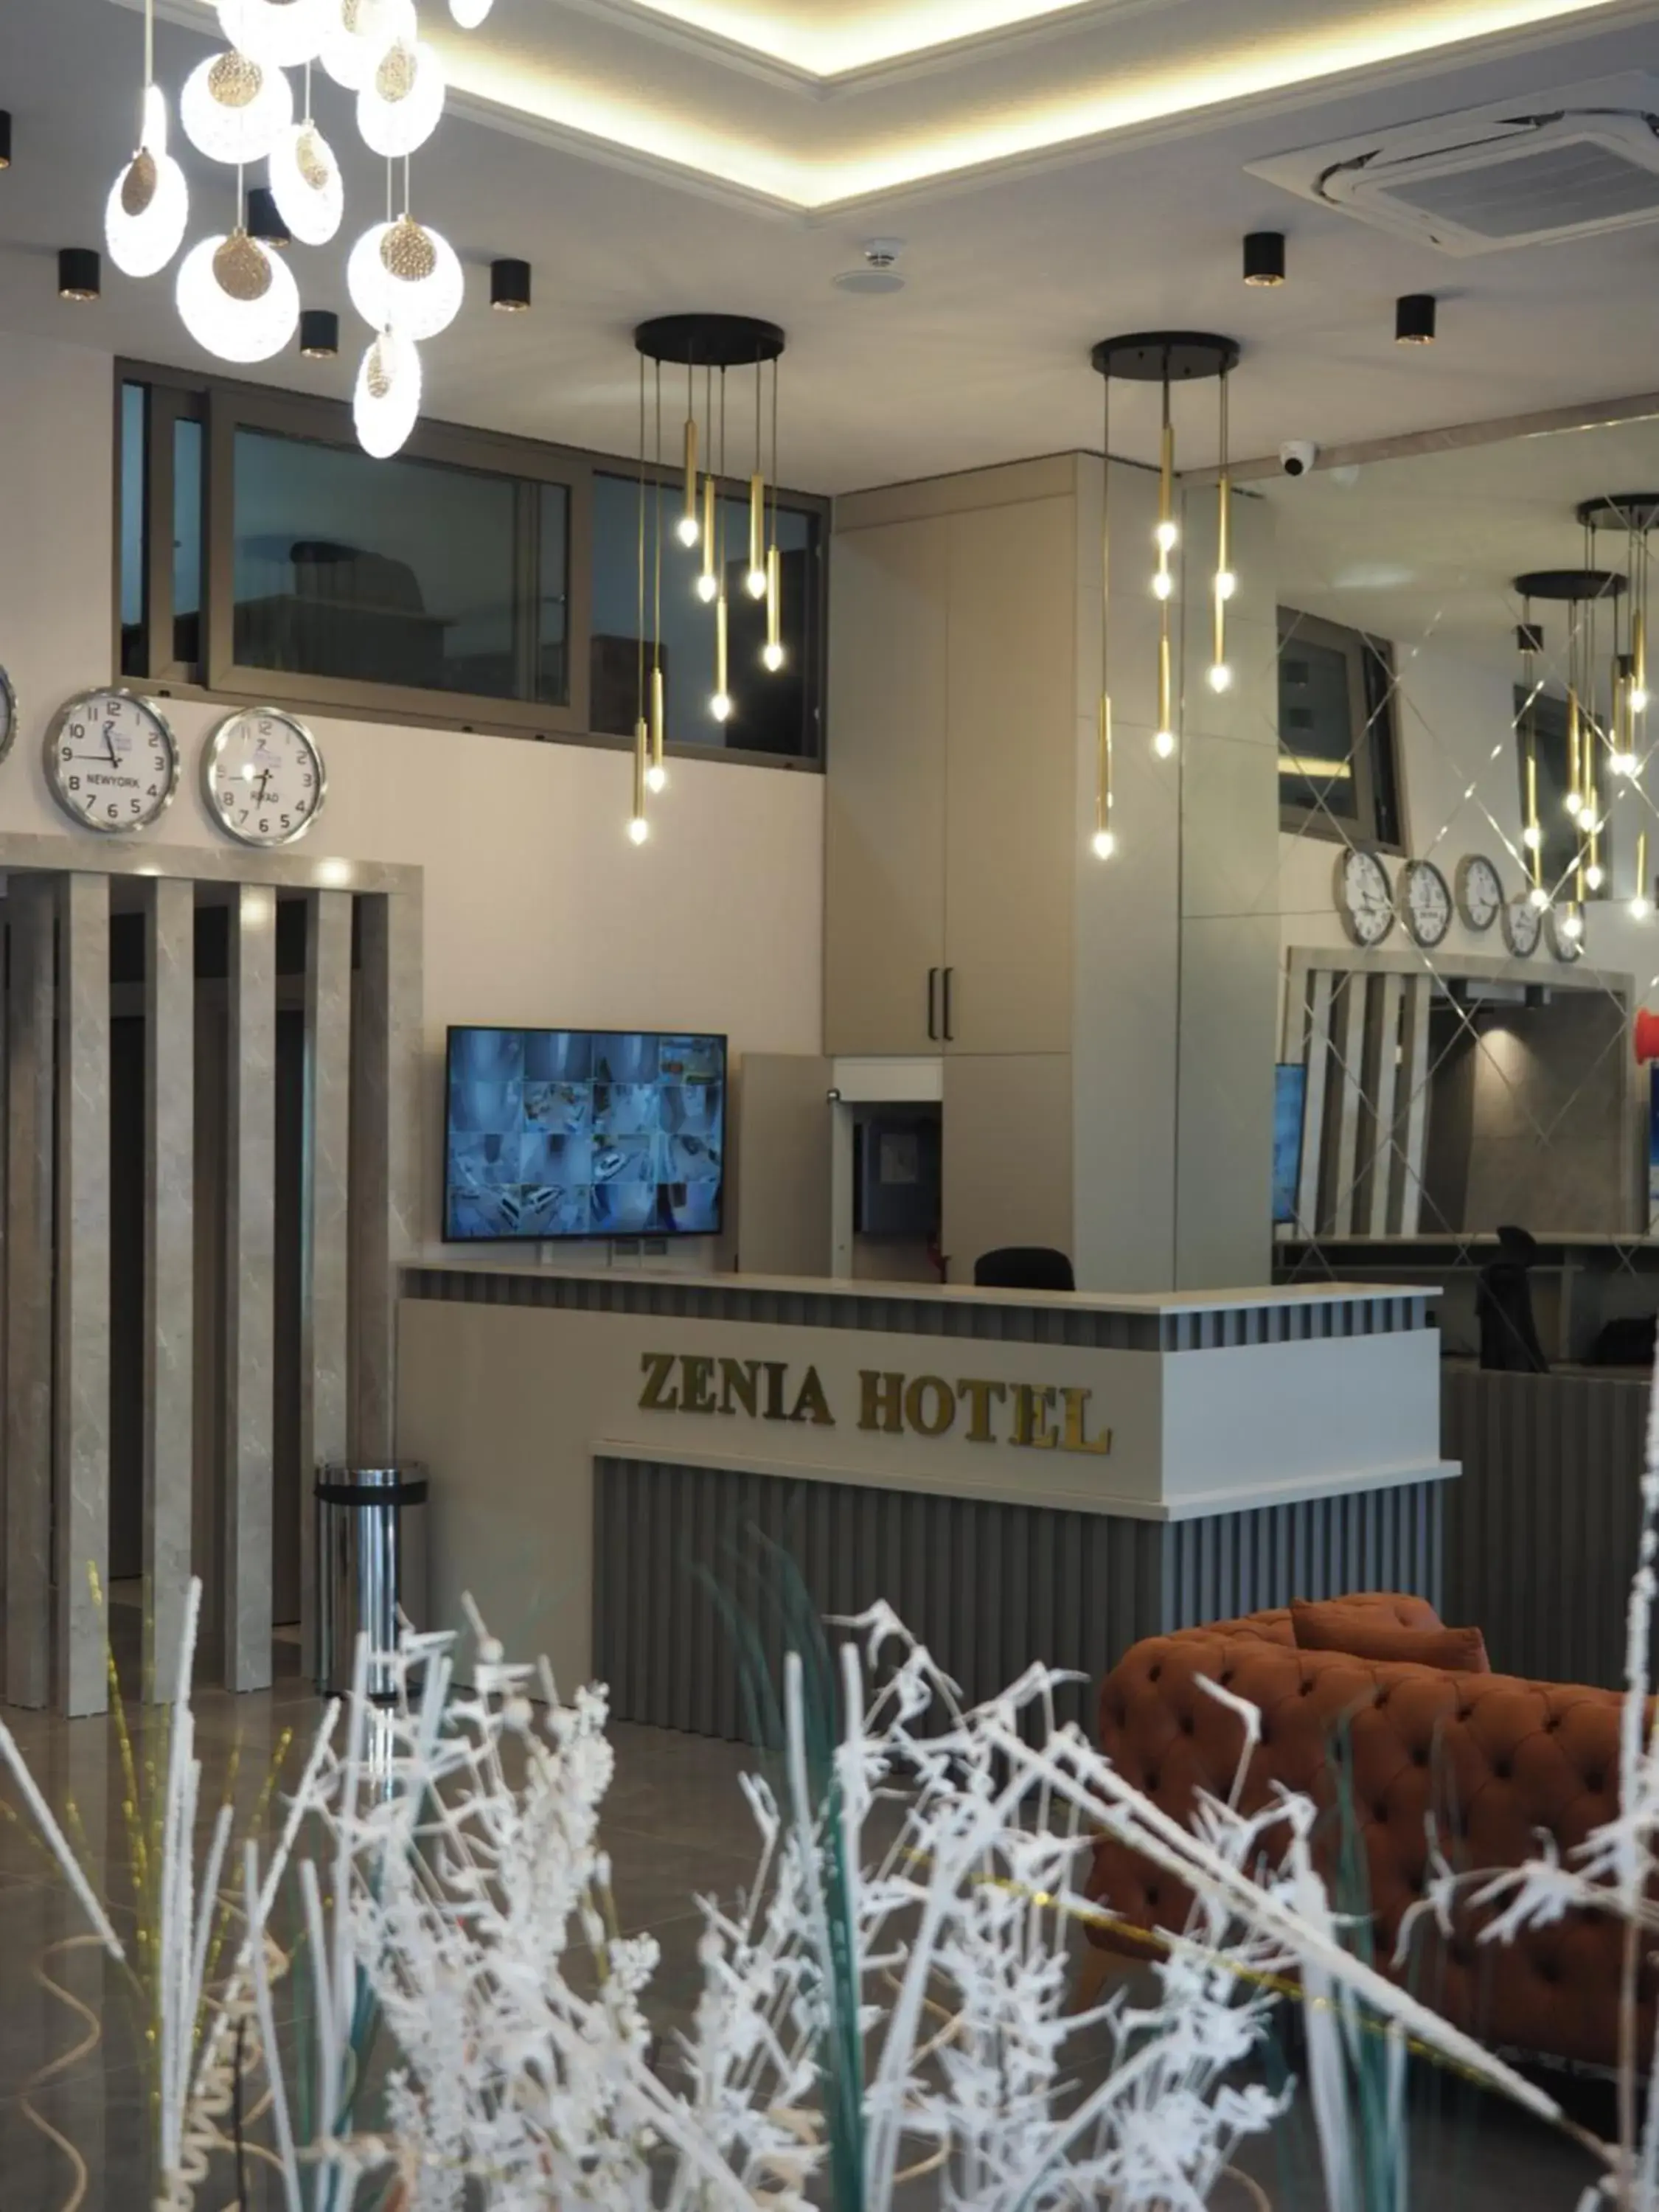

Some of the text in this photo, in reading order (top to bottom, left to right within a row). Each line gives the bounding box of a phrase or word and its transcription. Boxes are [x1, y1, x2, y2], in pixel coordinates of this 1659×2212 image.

[88, 707, 98, 721] 11
[107, 701, 121, 716] 12
[69, 724, 85, 739] 10
[259, 720, 272, 735] 12
[148, 732, 159, 748] 2
[62, 747, 72, 762] 9
[296, 751, 307, 765] 2
[154, 757, 164, 771] 3
[69, 776, 80, 790] 8
[86, 774, 140, 788] NEWYORK
[303, 773, 312, 787] 3
[147, 784, 157, 797] 4
[250, 791, 279, 803] RAD
[86, 794, 97, 810] 7
[131, 799, 141, 813] 5
[223, 792, 234, 806] 8
[295, 799, 305, 812] 4
[108, 804, 118, 818] 6
[239, 809, 248, 824] 7
[259, 818, 268, 832] 6
[280, 814, 290, 828] 5
[639, 1352, 1112, 1455] ZENIA HOTEL
